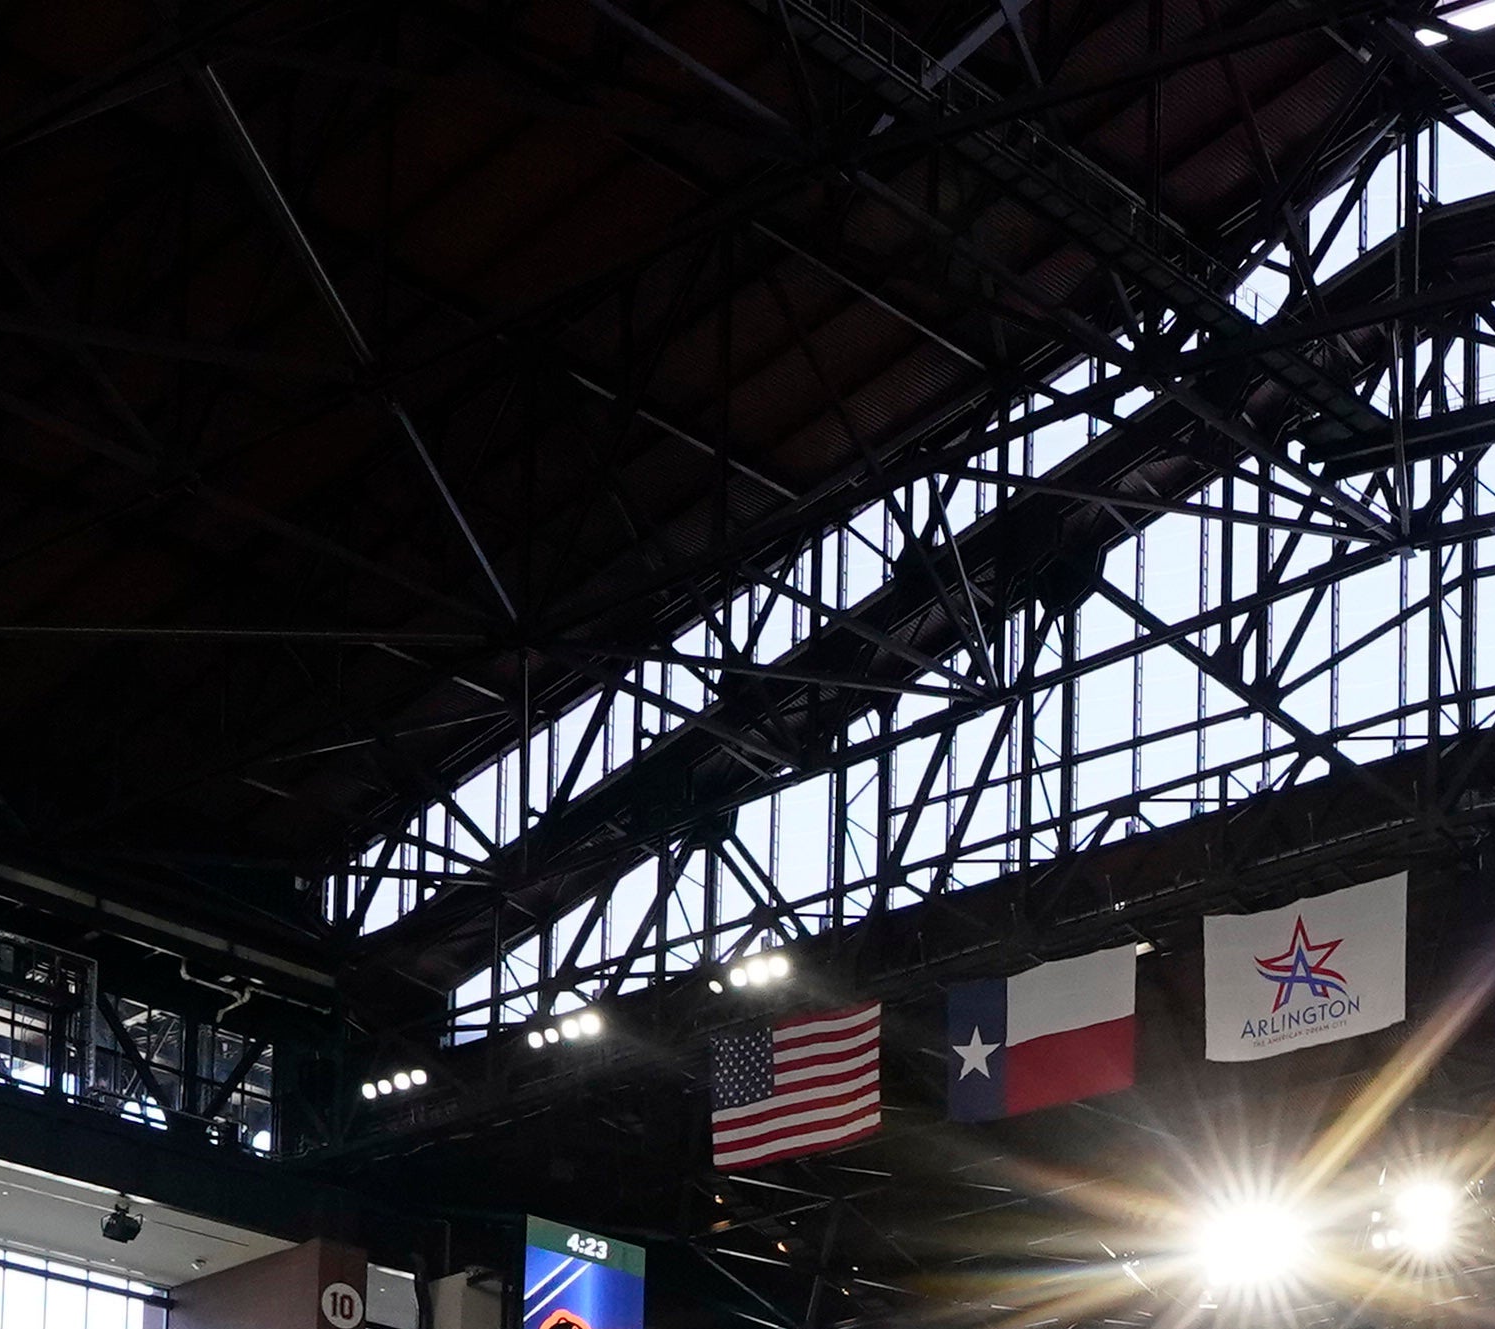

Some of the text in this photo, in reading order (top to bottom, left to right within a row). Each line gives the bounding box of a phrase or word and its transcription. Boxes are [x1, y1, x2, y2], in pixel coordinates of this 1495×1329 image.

[1241, 996, 1360, 1039] ARLINGTON
[567, 1233, 608, 1260] 4:23
[330, 1291, 355, 1320] 10
